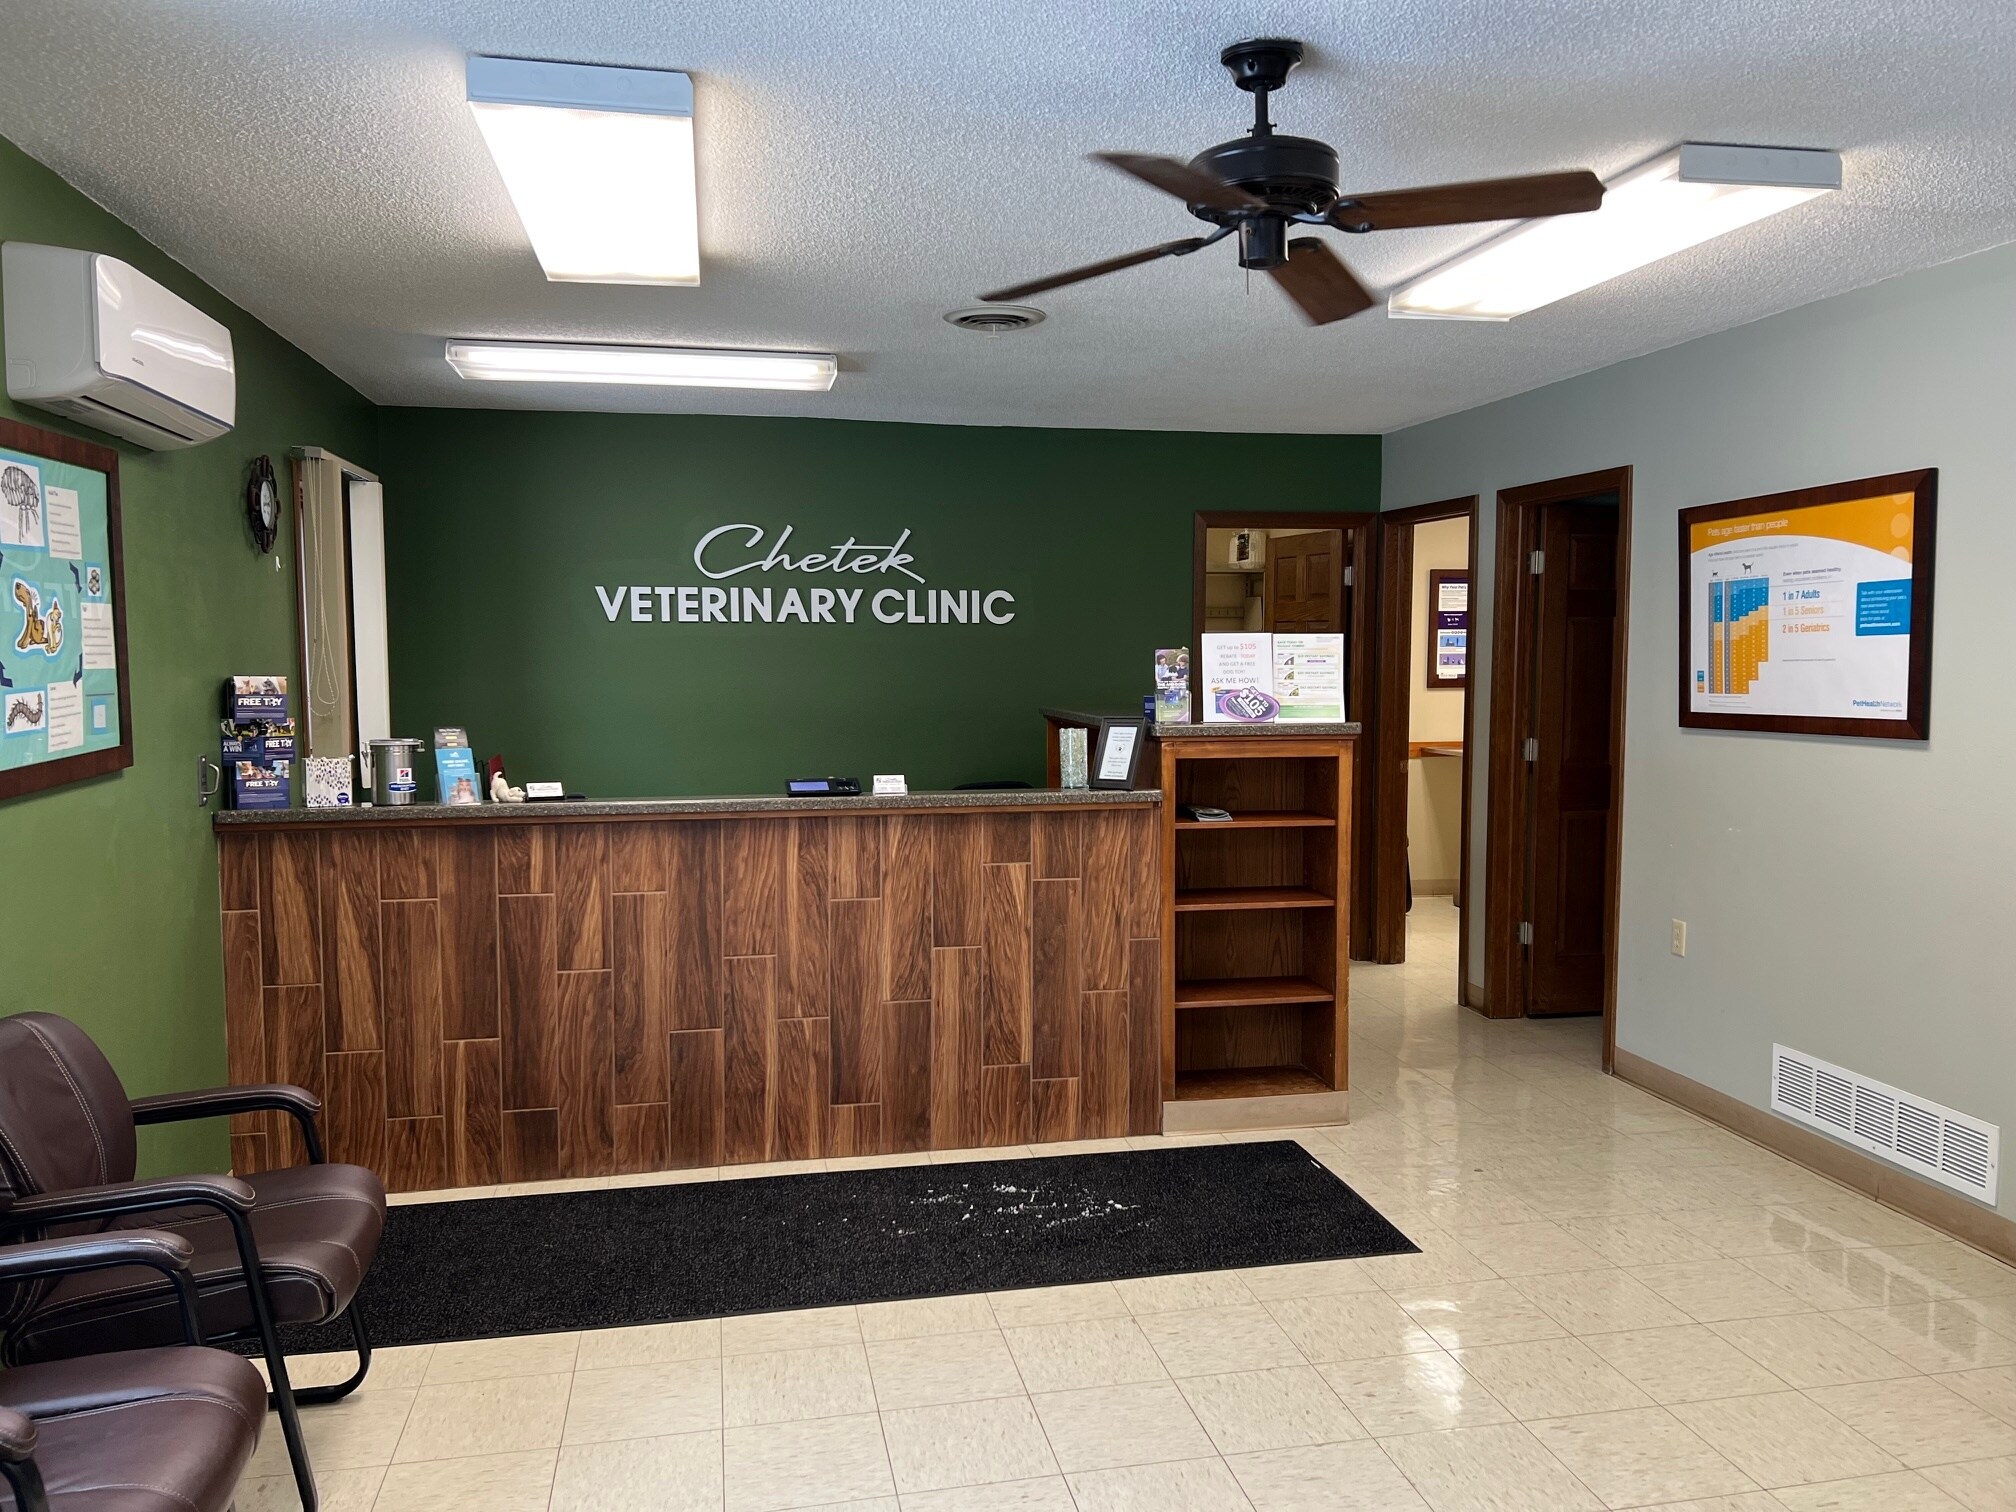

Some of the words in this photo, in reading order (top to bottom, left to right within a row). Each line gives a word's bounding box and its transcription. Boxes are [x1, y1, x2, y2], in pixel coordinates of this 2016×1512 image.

[1708, 528, 1720, 536] Pets
[1721, 528, 1732, 536] age
[1751, 522, 1765, 531] than
[1766, 518, 1788, 530] people
[693, 523, 926, 584] Chetek
[1782, 592, 1786, 600] 1
[1788, 590, 1794, 600] in
[1796, 590, 1800, 600] 7
[1800, 590, 1820, 600] Adults
[595, 586, 864, 624] VETERINARY
[871, 588, 1016, 625] CLINIC
[1783, 608, 1786, 616] 1
[1788, 607, 1794, 615] in
[1795, 606, 1799, 615] 5
[1800, 605, 1824, 615] Seniors
[1782, 624, 1787, 634] 2
[1788, 624, 1794, 633] in
[1795, 624, 1799, 633] 5
[1800, 623, 1830, 633] Geriatrics
[238, 698, 262, 706] FREE
[1240, 688, 1266, 716] $105
[1852, 700, 1902, 708] PetHealthNetwork
[265, 740, 280, 748] FREE
